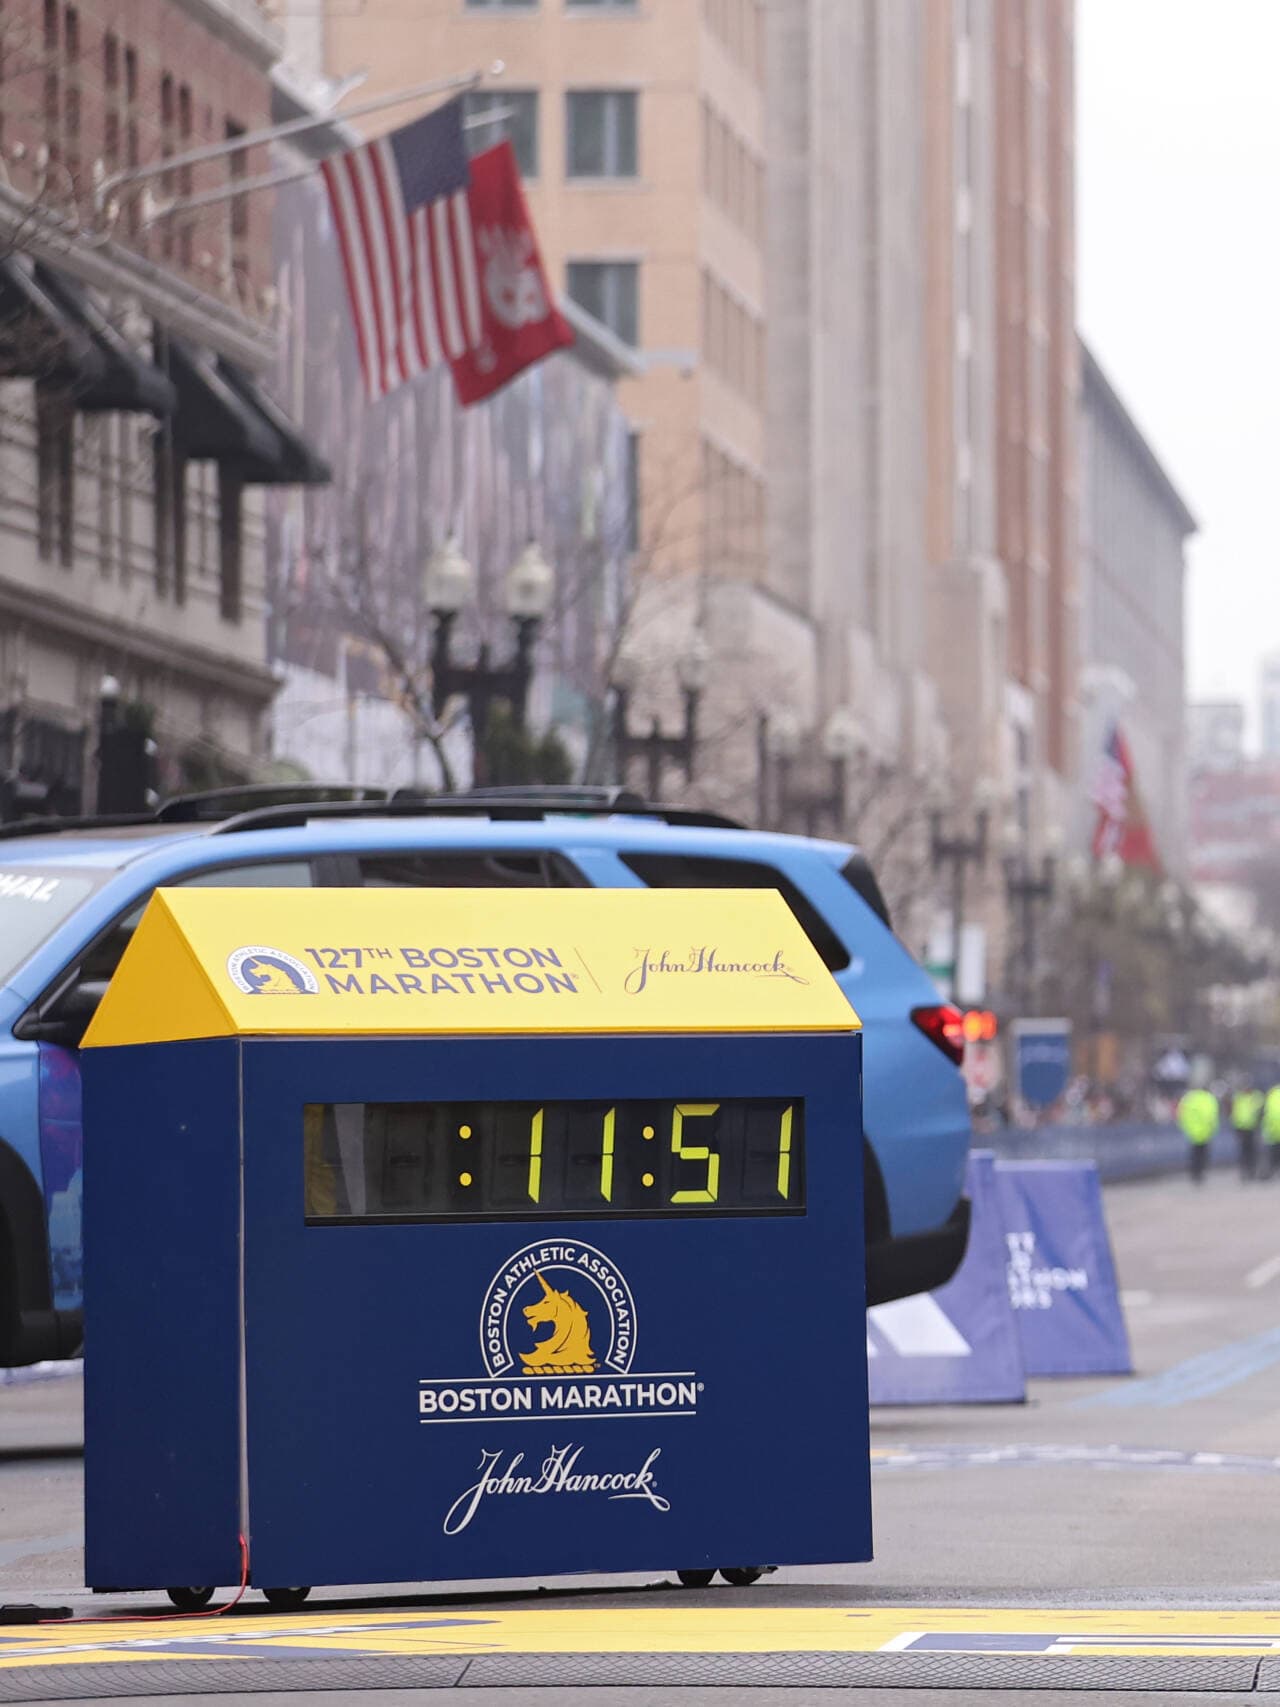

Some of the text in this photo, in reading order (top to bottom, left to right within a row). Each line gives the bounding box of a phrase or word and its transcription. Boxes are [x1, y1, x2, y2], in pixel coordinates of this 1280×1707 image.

[398, 947, 563, 969] BOSTON
[623, 946, 810, 994] John Hancock
[487, 1246, 631, 1368] BOSTON ATHLETIC ASSOCIATION
[419, 1386, 532, 1414] BOSTON
[443, 1442, 671, 1535] John Hancock
